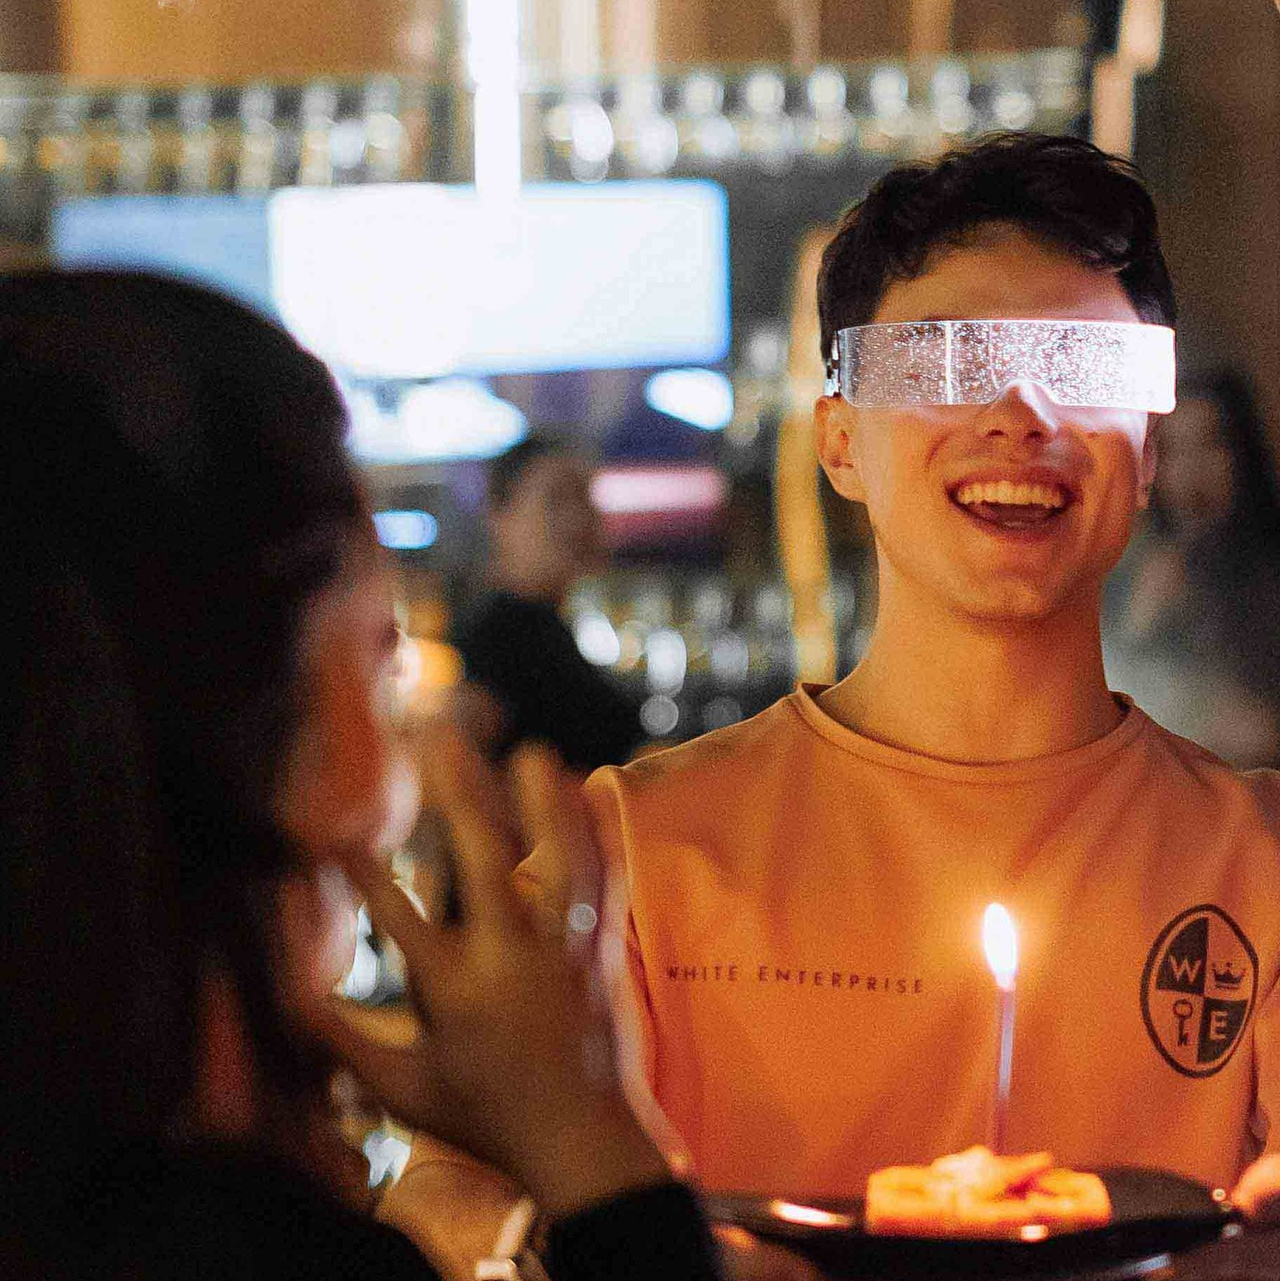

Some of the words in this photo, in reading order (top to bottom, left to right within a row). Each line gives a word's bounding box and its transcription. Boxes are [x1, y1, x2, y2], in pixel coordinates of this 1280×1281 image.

[666, 965, 738, 982] WHITE
[758, 965, 924, 994] ENTERPRISE
[1169, 955, 1201, 985] W
[1209, 1010, 1229, 1040] E
